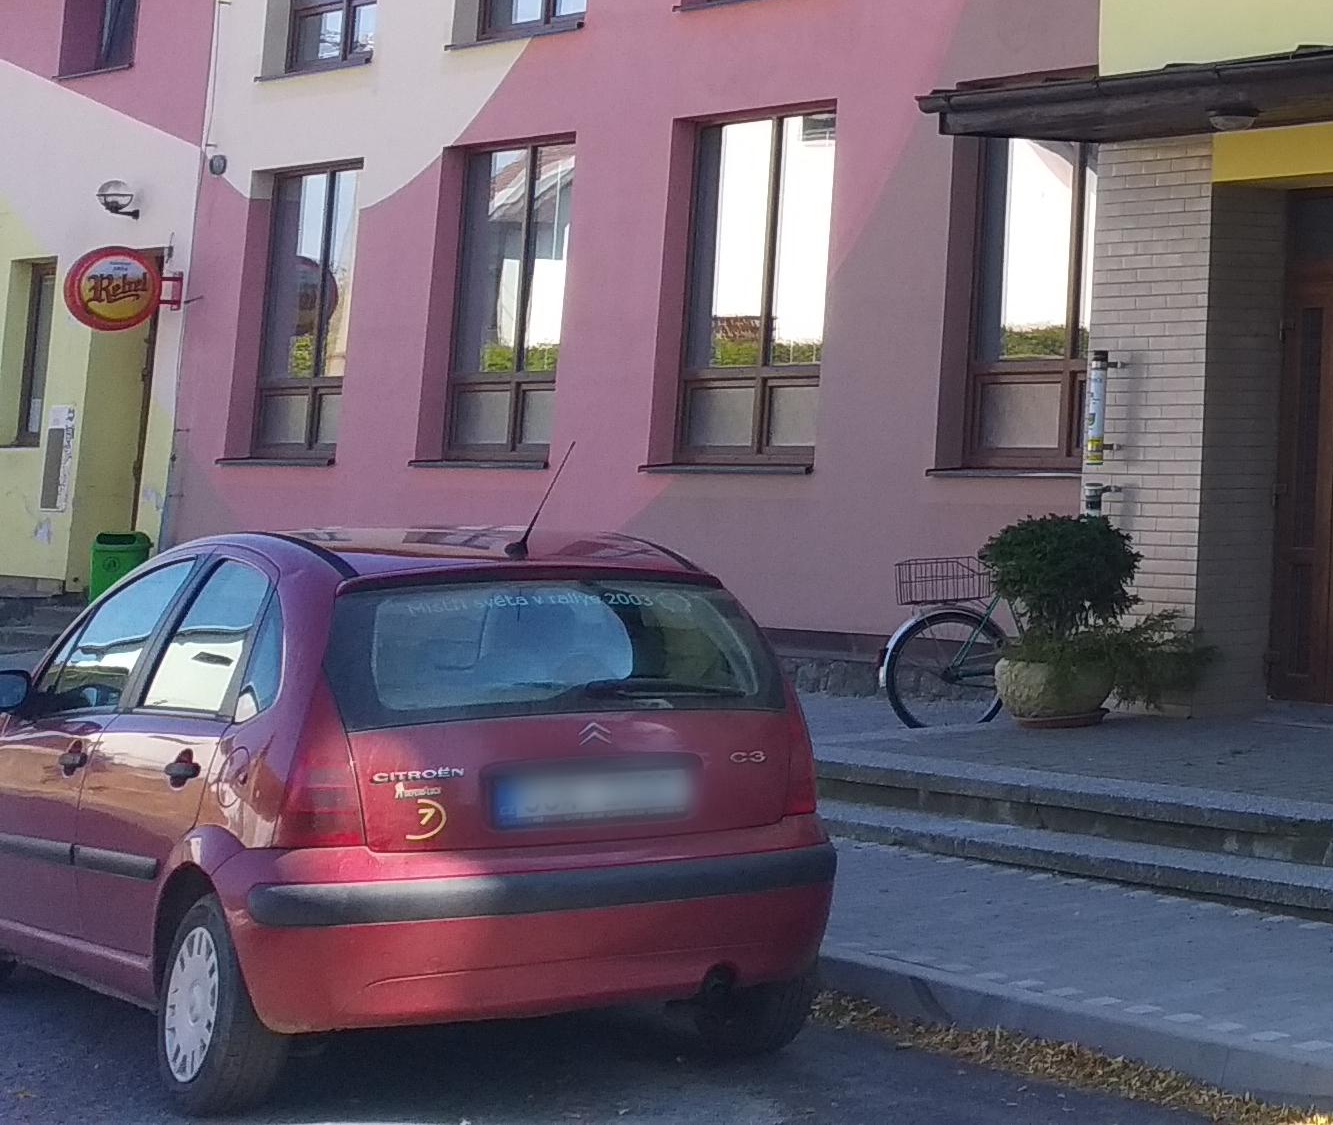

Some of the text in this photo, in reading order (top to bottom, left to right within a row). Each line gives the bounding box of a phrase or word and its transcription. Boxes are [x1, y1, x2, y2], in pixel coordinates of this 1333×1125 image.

[86, 272, 148, 304] Rebel
[604, 592, 655, 607] 2003
[730, 750, 767, 763] C3
[372, 766, 465, 784] CITROËN
